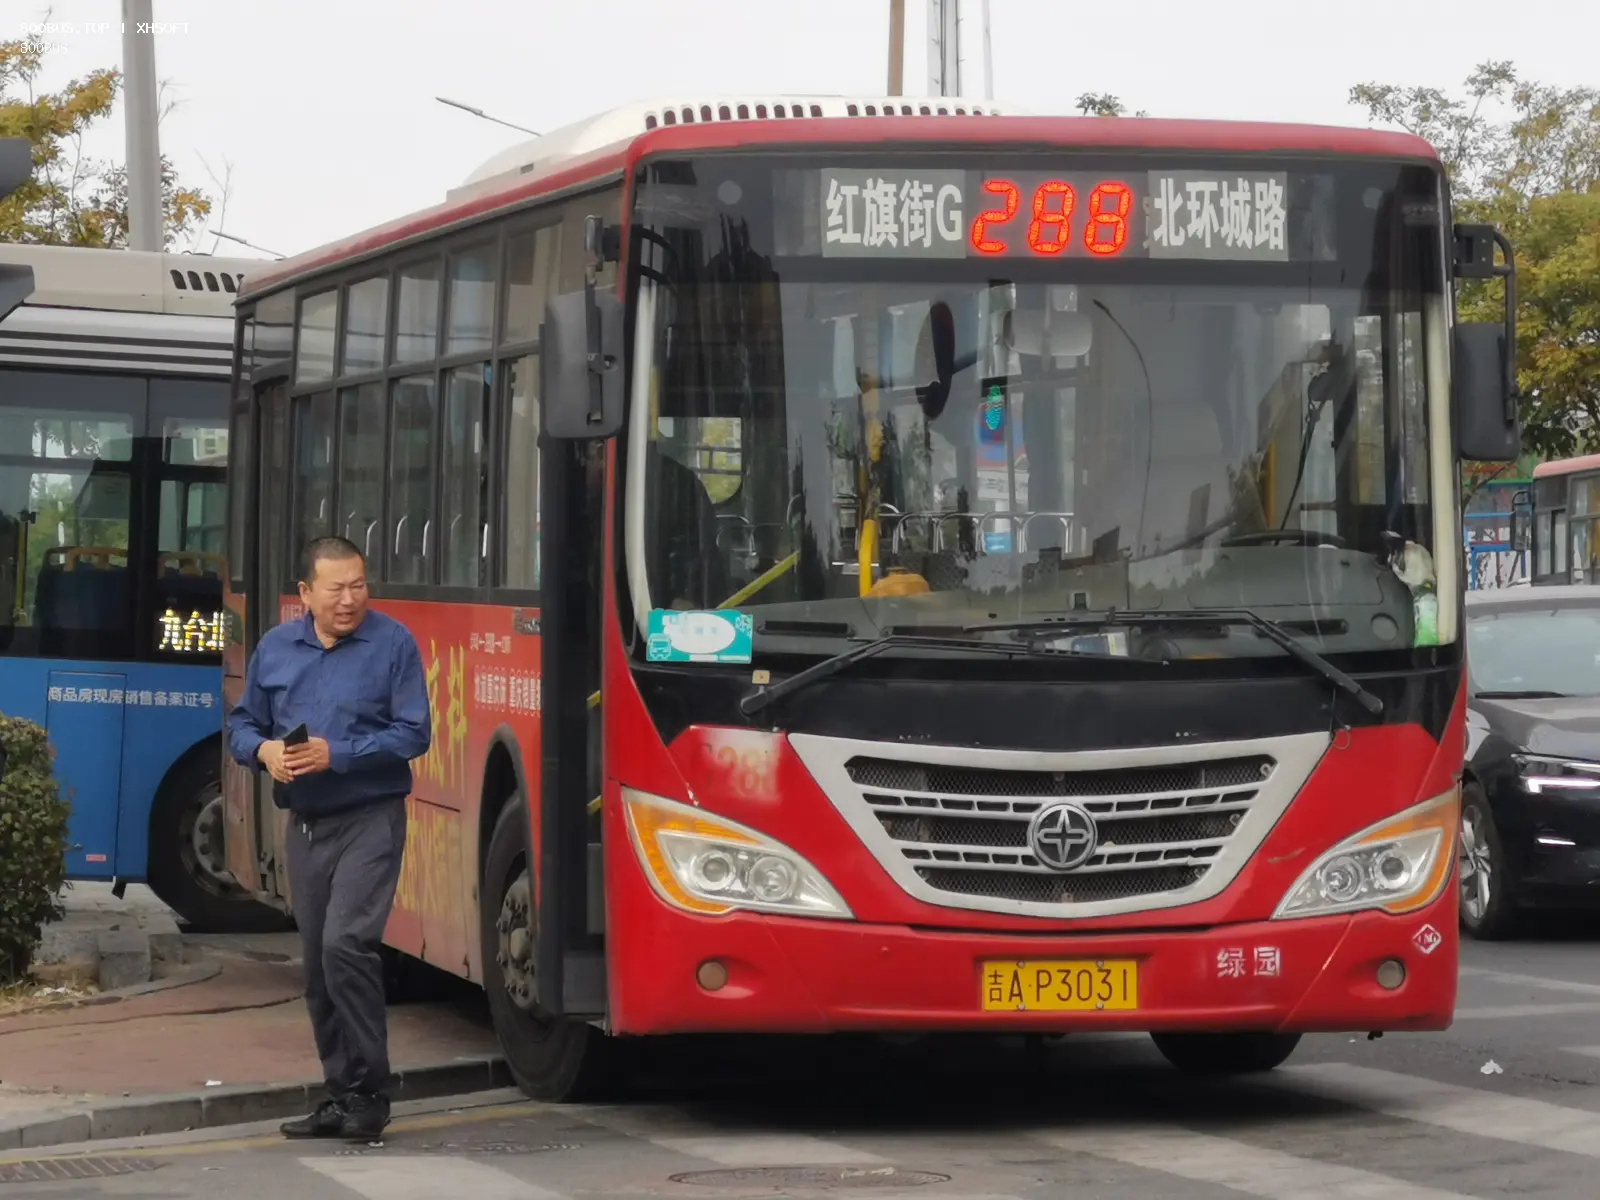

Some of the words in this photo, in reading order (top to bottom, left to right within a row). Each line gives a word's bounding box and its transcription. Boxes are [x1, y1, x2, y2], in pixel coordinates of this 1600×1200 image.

[826, 178, 963, 248] 红旗街G
[972, 179, 1134, 255] 288
[1153, 177, 1287, 251] 北环城路
[47, 686, 213, 708] 商品房现房销售备案证号
[1216, 946, 1281, 977] 绿园
